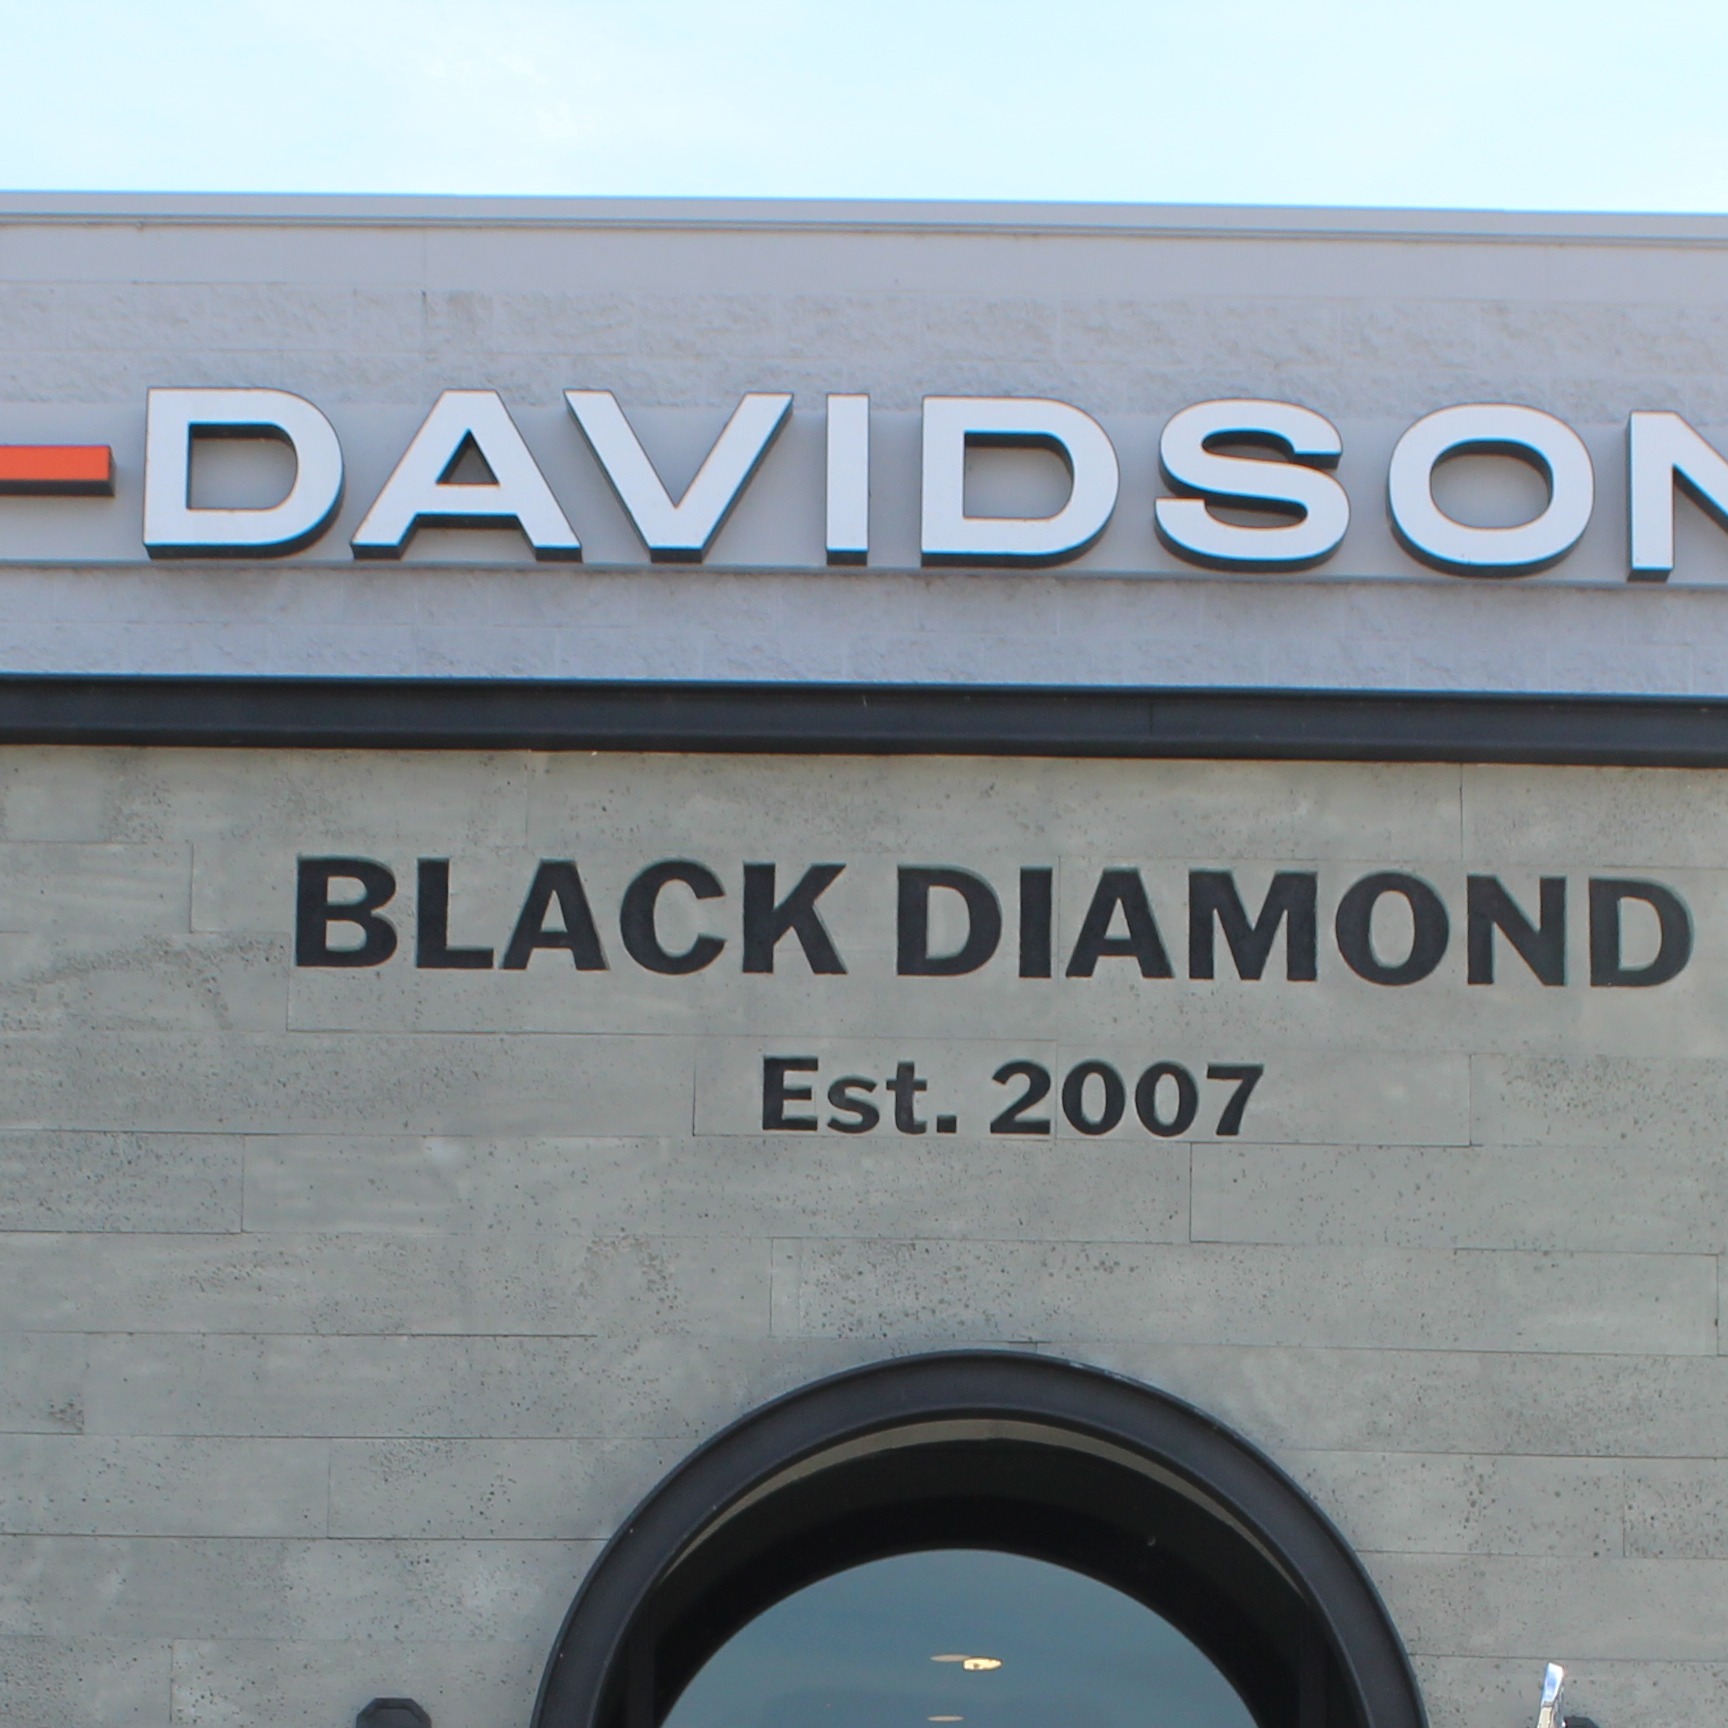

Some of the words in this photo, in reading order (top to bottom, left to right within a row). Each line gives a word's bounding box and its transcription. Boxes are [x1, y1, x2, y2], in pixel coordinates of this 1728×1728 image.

[294, 855, 849, 977] BLACK
[895, 864, 1694, 989] DIAMOND
[761, 1054, 958, 1136] Est.
[988, 1059, 1265, 1139] 2007
